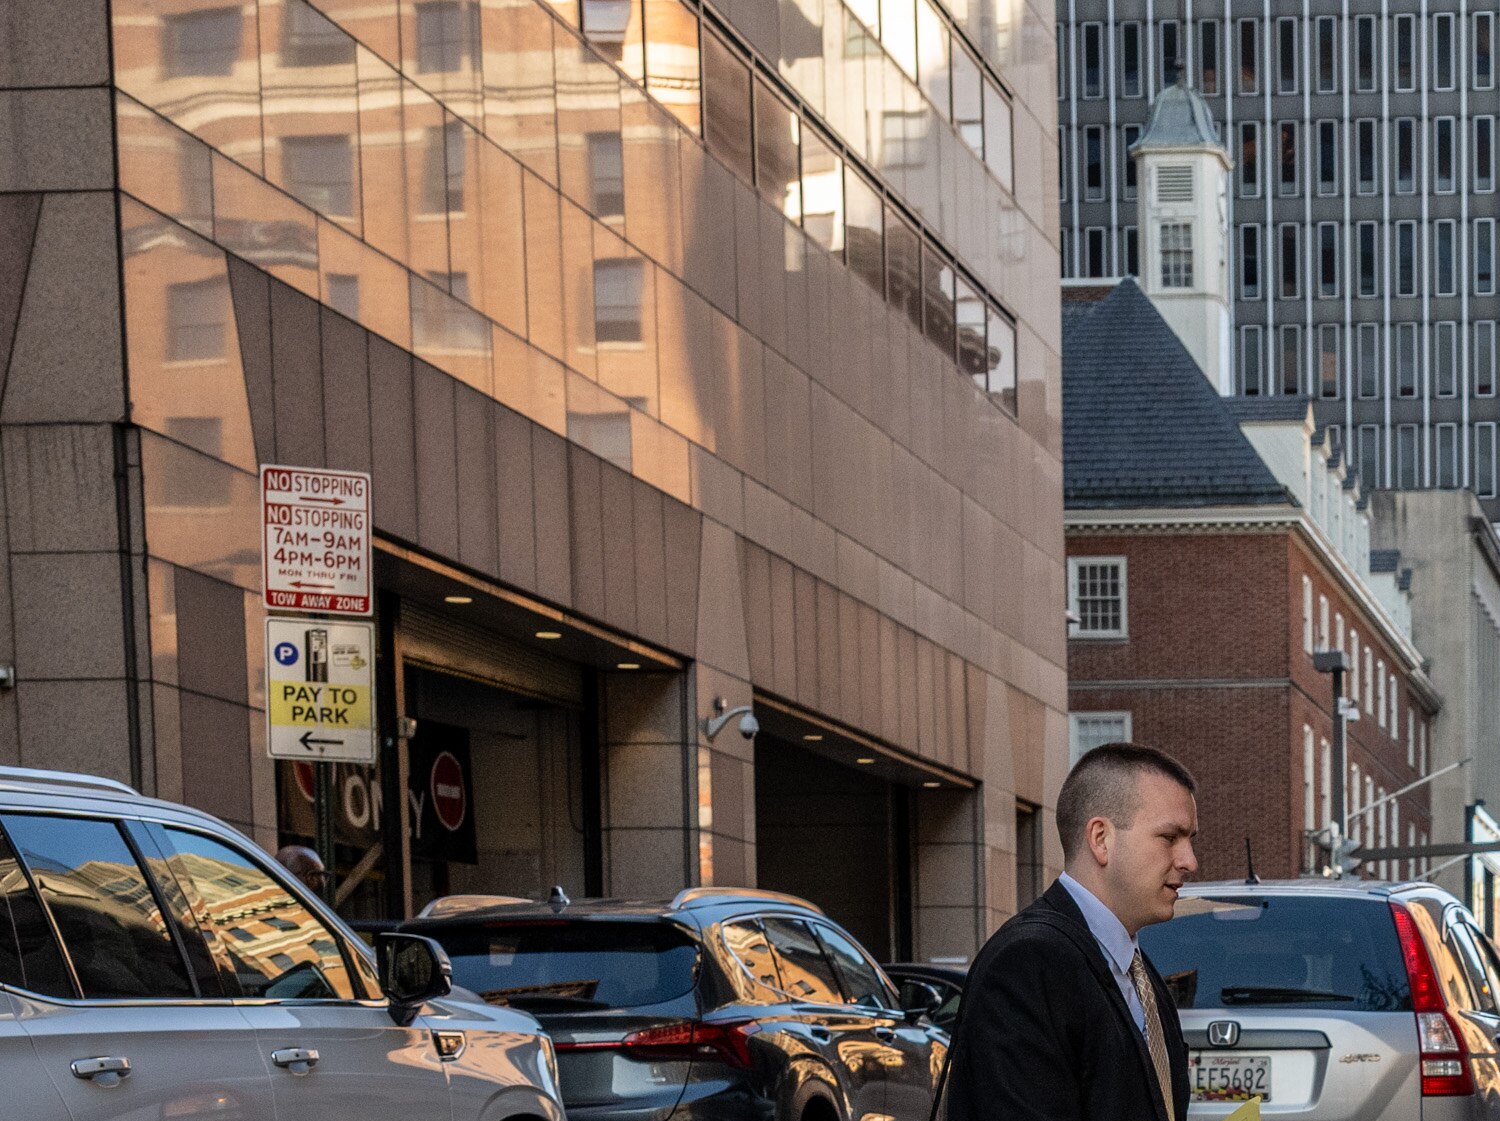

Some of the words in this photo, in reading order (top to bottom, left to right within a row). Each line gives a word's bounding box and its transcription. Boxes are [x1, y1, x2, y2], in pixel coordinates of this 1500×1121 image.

[267, 472, 290, 490] NO
[295, 475, 363, 497] STOPPING
[267, 505, 290, 523] NO
[295, 509, 363, 530] STOPPING
[274, 548, 361, 571] 4PM-6PM
[279, 569, 302, 577] MON
[307, 571, 335, 580] THRU
[340, 573, 357, 581] FRI
[271, 592, 296, 606] TOW
[301, 594, 331, 609] AWAY
[336, 596, 365, 611] ZONE
[283, 685, 322, 703] PAY
[329, 688, 357, 705] TO
[292, 706, 349, 724] PARK
